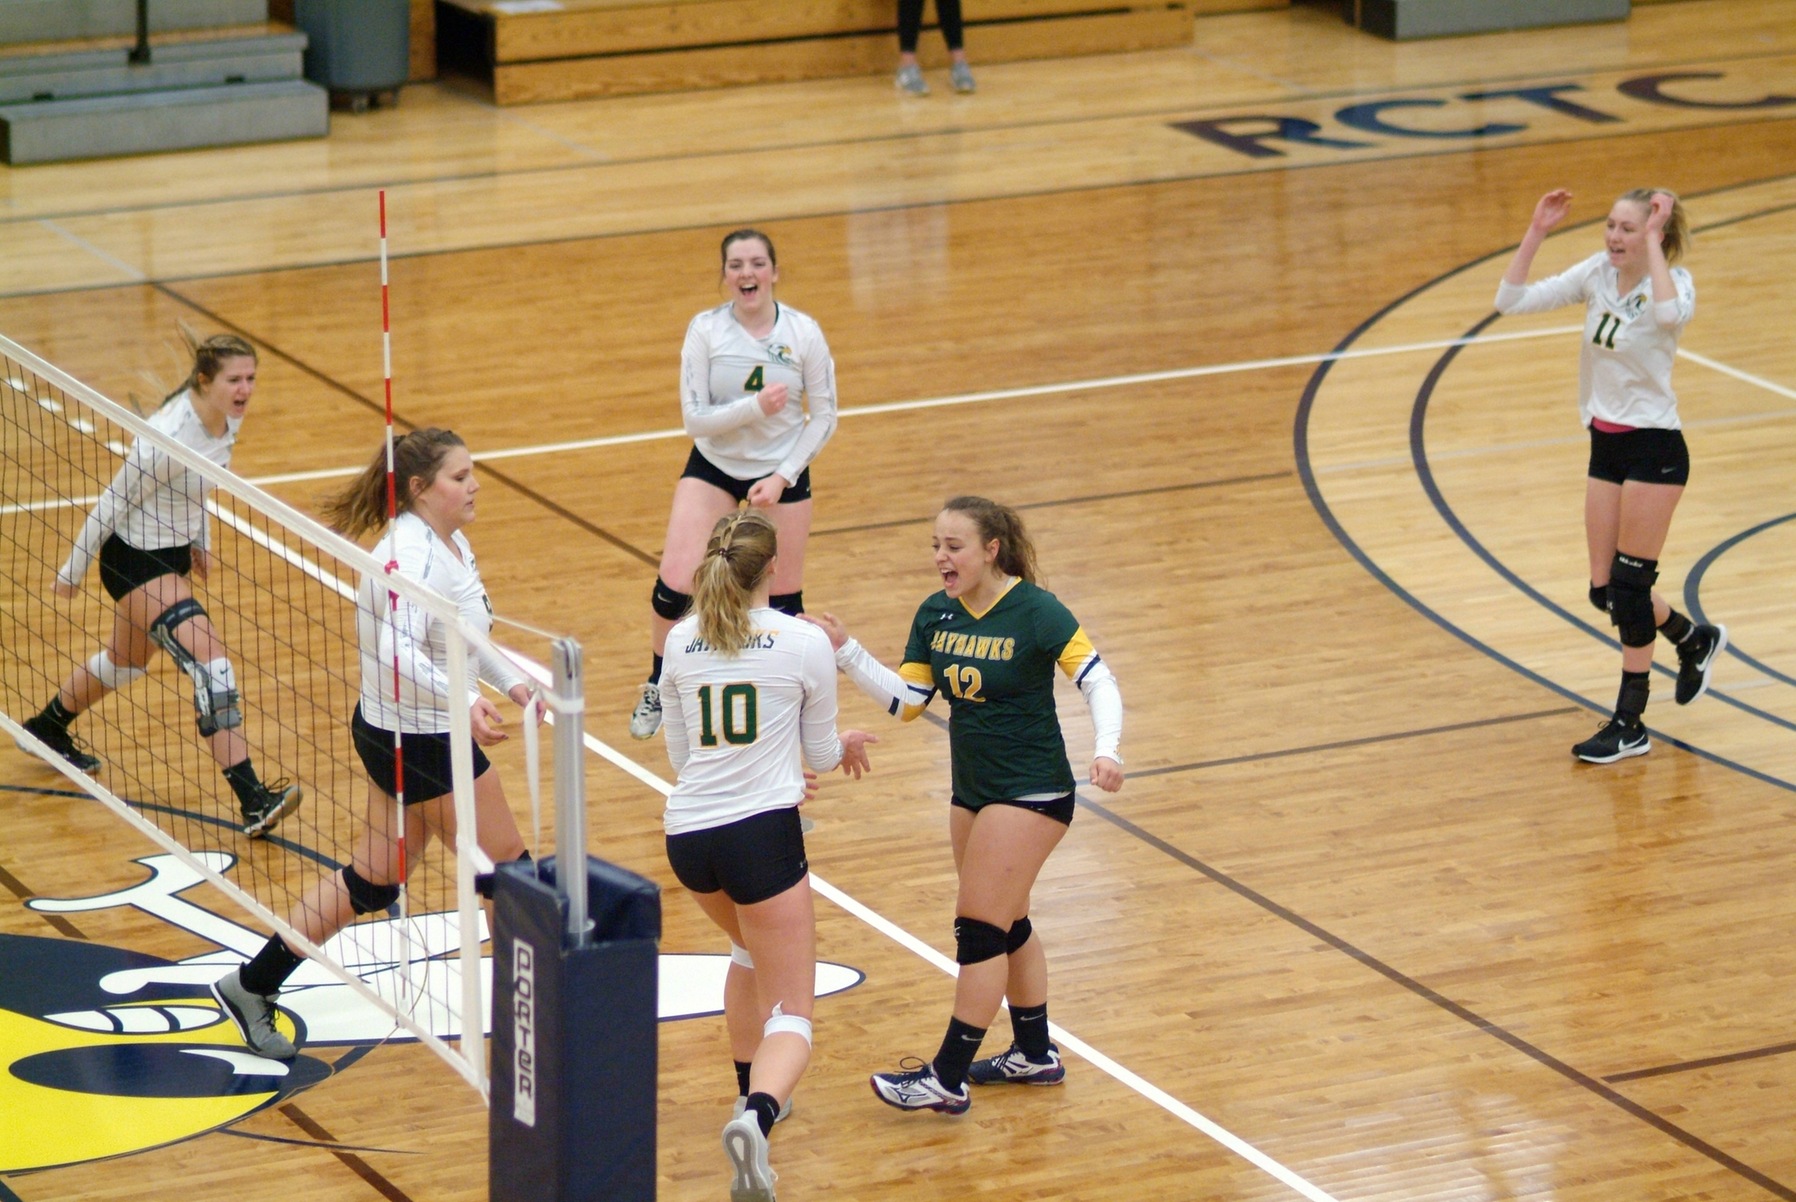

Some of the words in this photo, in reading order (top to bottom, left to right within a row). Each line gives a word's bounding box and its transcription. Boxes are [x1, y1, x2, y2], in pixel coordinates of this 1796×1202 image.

[1165, 71, 1796, 158] RCTC
[1592, 311, 1621, 351] 11
[743, 364, 765, 393] 4
[930, 630, 1016, 661] JAYHAWKS
[943, 663, 986, 703] 12
[697, 682, 759, 748] 10
